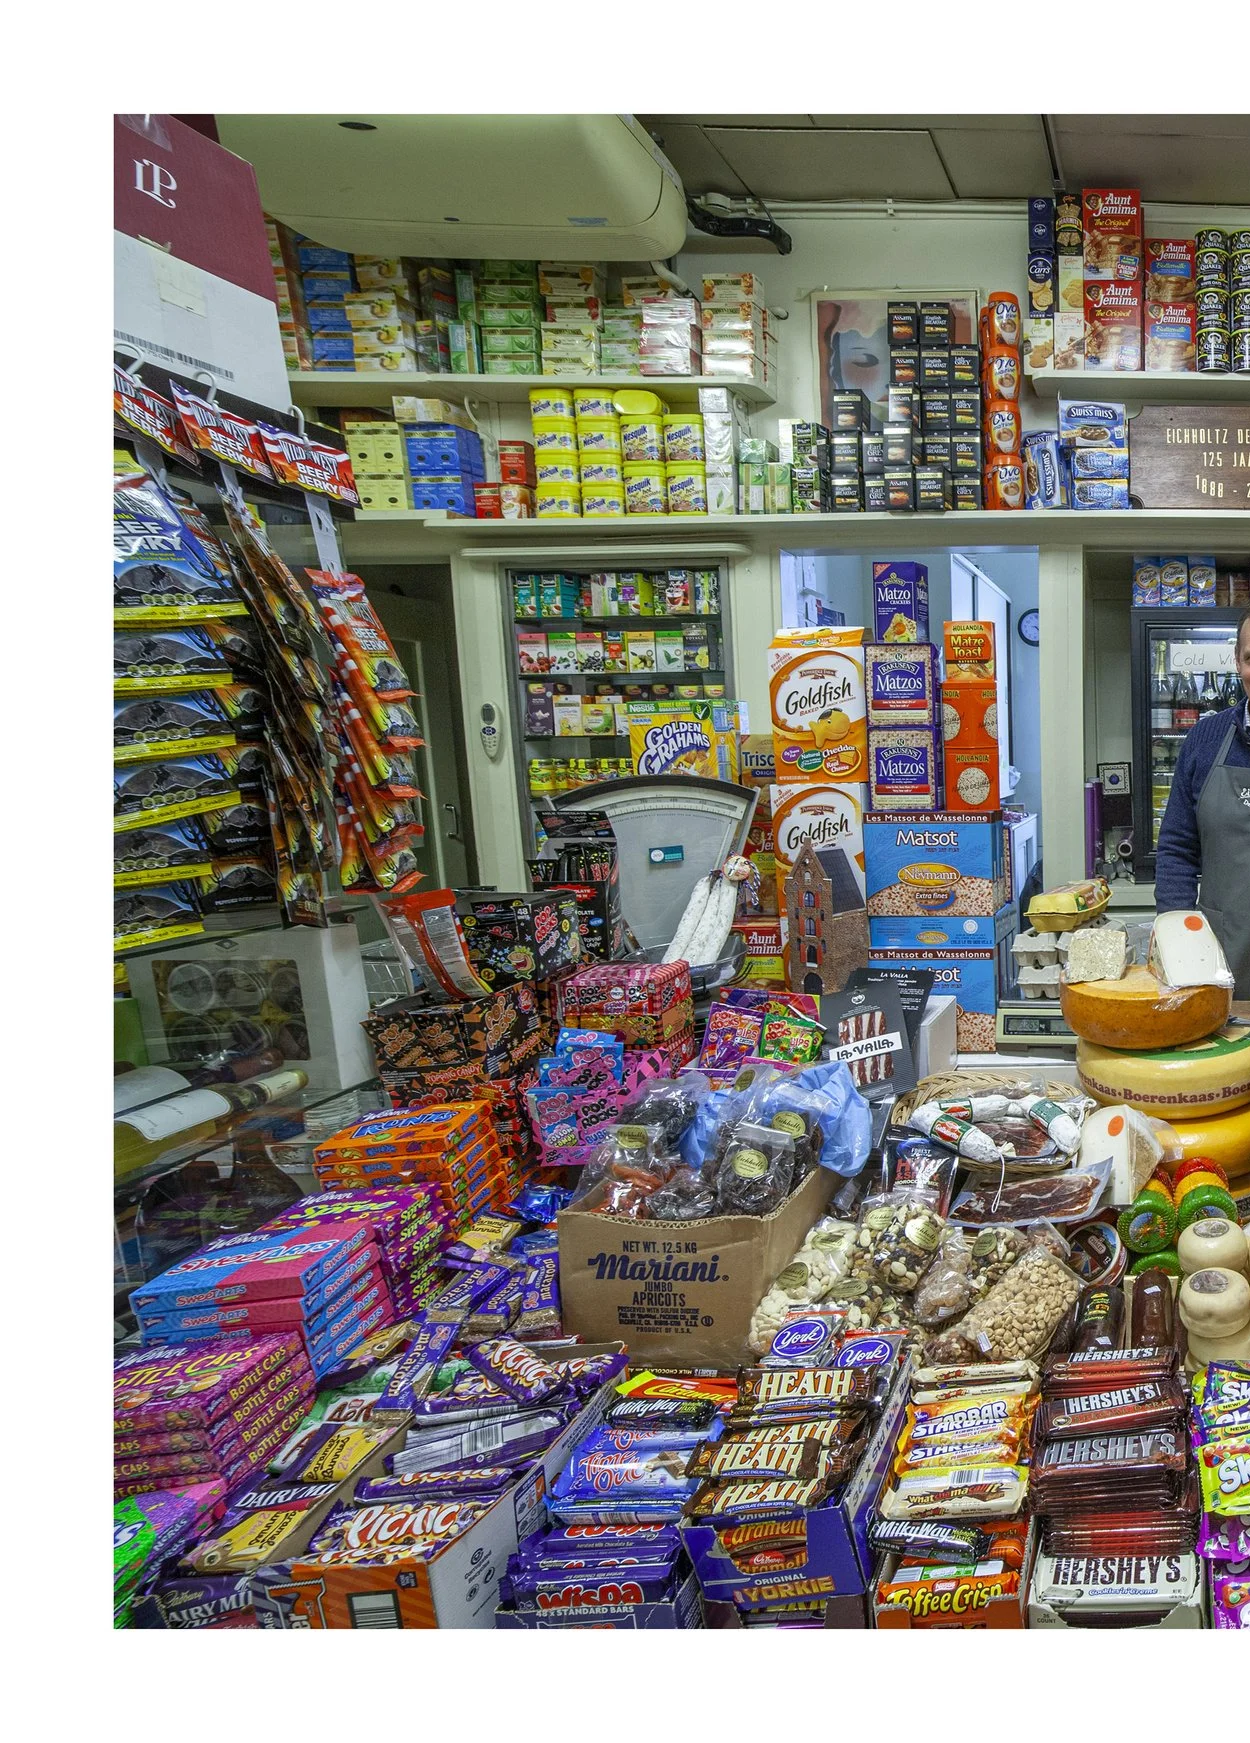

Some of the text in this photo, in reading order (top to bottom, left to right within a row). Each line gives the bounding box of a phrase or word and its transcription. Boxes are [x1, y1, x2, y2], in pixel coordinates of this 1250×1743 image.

[1105, 193, 1131, 205] Aunt
[1096, 205, 1137, 216] Jemima
[1166, 242, 1186, 252] Aunt
[1159, 252, 1191, 262] Jemima
[1200, 263, 1222, 271] QUAKER
[1106, 284, 1132, 296] Aunt
[1098, 296, 1138, 307] Jemima
[1165, 306, 1187, 316] Aunt
[1159, 316, 1191, 325] Jemima
[210, 429, 244, 452] BEEF
[623, 424, 647, 442] Nesquik
[666, 426, 691, 442] Nesquik
[1167, 429, 1228, 444] EICHHOLTZ
[211, 442, 252, 467] JERKY
[1203, 453, 1222, 467] 125
[296, 462, 331, 481] BEEF
[297, 475, 338, 494] JERKY
[627, 478, 650, 494] Nesquik
[1196, 475, 1223, 497] 1888
[878, 587, 910, 602] Matzo
[951, 636, 984, 647] Matze
[953, 647, 981, 657] Toast
[1172, 651, 1204, 667] Cold
[876, 675, 922, 691] Matzos
[786, 678, 852, 715] Goldfish
[639, 733, 710, 774] GRAHAMS
[879, 761, 924, 777] Matzos
[897, 831, 958, 846] Matsot
[905, 869, 957, 881] Neymann
[1123, 1089, 1215, 1104] Boerenkaas
[622, 1241, 697, 1253] NET WT. 12.5 KG
[588, 1253, 720, 1283] Mariani
[645, 1282, 672, 1292] JUMBO
[633, 1292, 685, 1306] APRICOTS
[780, 1327, 824, 1349] York
[844, 1345, 887, 1366] York
[1073, 1348, 1153, 1362] HERSHEY'S
[230, 1345, 287, 1400] BOTTLE CAPS
[761, 1371, 853, 1398] HEATH
[1068, 1385, 1156, 1414] HERSHEY'S
[1044, 1433, 1175, 1465] HERSHEY'S
[716, 1443, 803, 1472] HEATH
[721, 1479, 818, 1510] HEATH
[1053, 1556, 1181, 1585] HERSHEY'S
[754, 1574, 806, 1584] ORIGINAL
[748, 1577, 836, 1600] YORKIE
